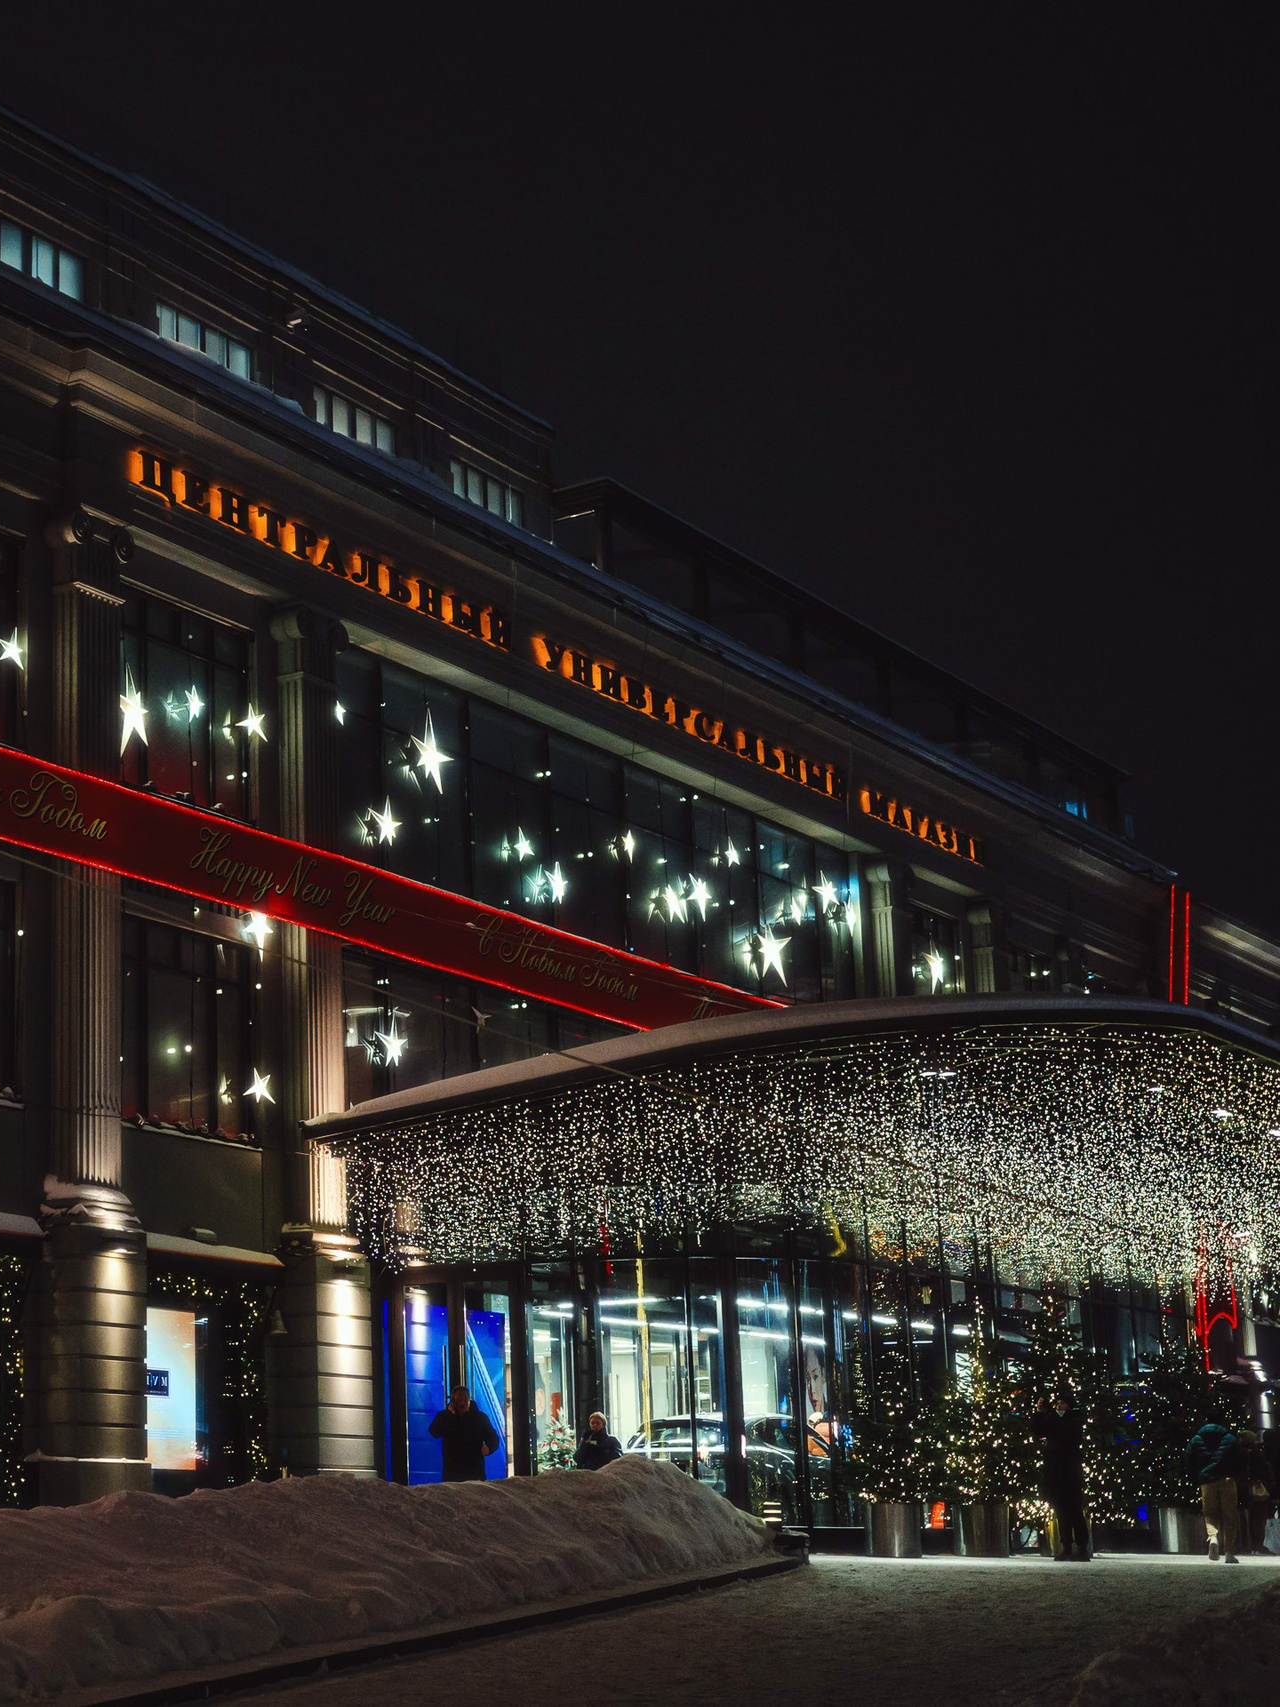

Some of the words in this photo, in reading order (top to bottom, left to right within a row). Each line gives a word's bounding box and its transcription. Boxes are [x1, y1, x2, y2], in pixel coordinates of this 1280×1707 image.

[134, 449, 513, 653] ЦЕНТРАЛЬНЫЙ
[536, 637, 850, 803] УНИВЕРСАЛЬНЫЙ
[9, 770, 108, 840] Годом
[189, 826, 275, 903] Happy
[275, 856, 332, 906] New
[339, 870, 399, 927] Year
[498, 922, 576, 981] Новым
